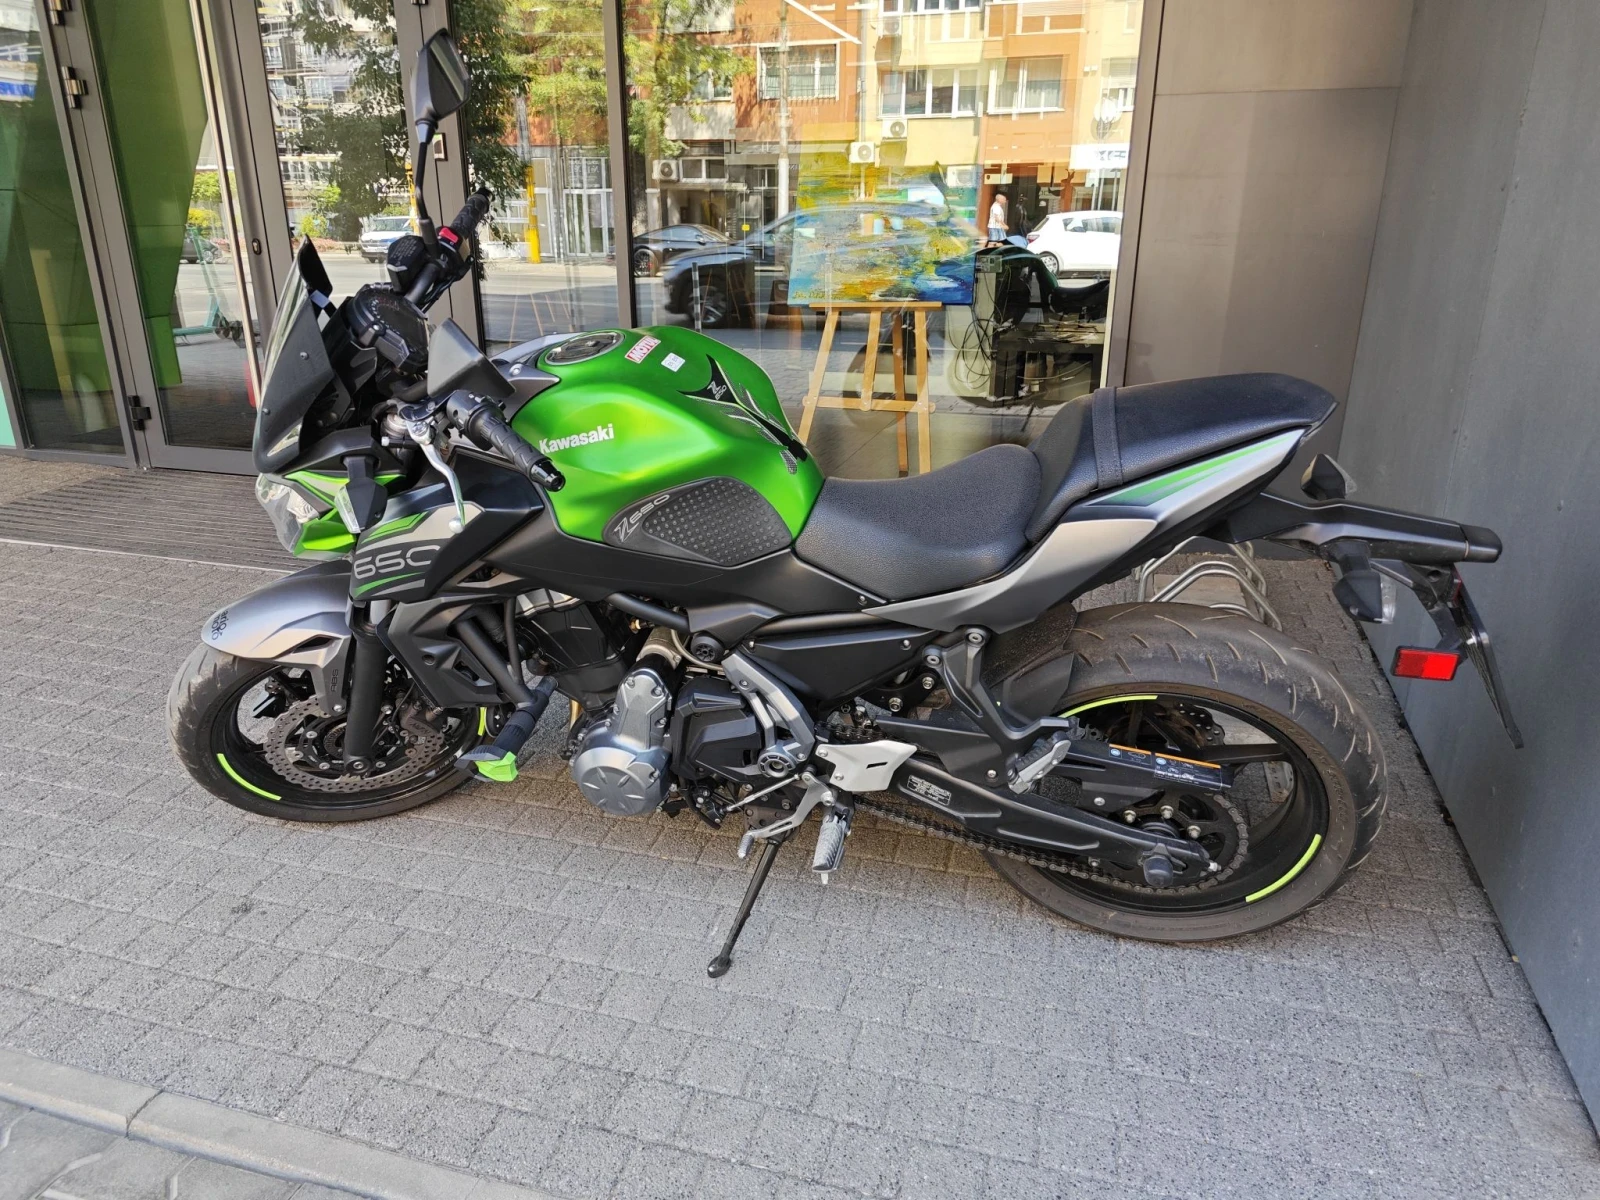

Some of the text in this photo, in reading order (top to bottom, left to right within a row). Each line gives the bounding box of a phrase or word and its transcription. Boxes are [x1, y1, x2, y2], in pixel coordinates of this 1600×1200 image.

[626, 336, 660, 363] MOTUL
[539, 423, 615, 455] Kawasaki
[330, 668, 339, 692] ABS
